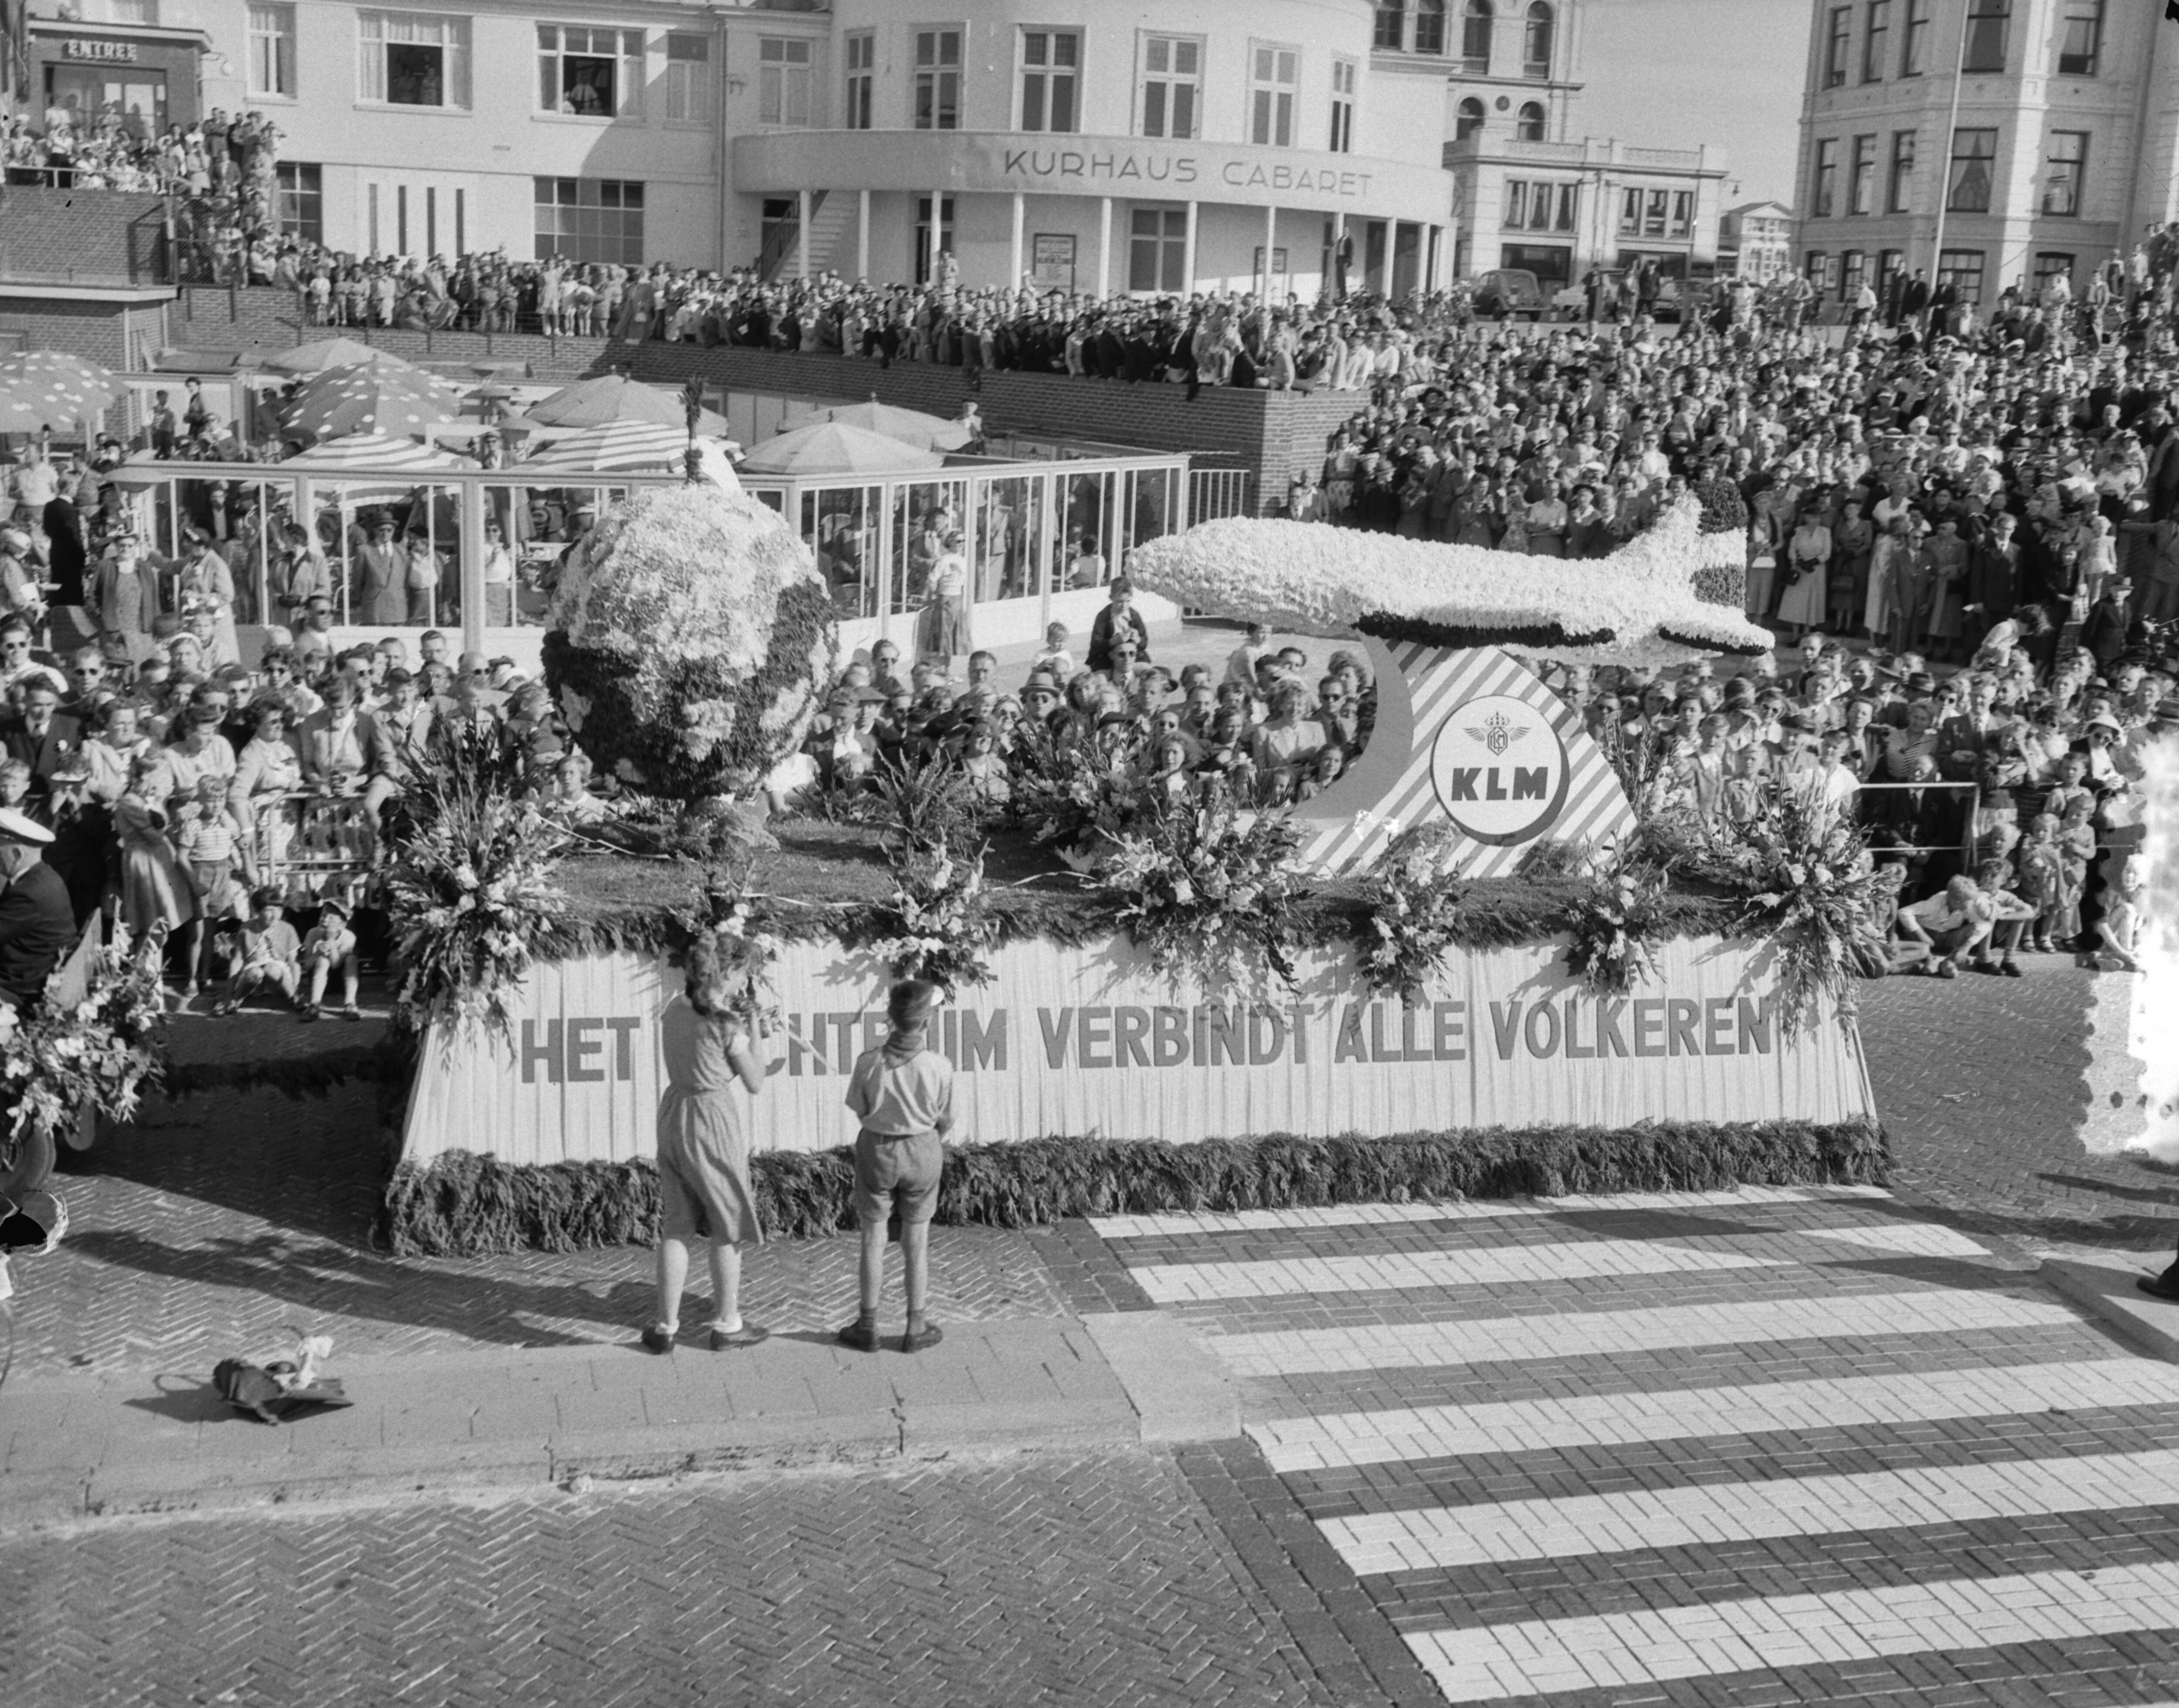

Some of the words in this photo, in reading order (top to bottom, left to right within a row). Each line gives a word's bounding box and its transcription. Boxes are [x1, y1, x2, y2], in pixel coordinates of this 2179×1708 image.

[68, 39, 137, 61] ENTREE
[1005, 149, 1198, 183] KURHAUS
[1222, 161, 1372, 196] CABARET
[1451, 767, 1548, 801] KLM
[522, 1016, 641, 1083] HET
[1037, 1005, 1315, 1070] VERBINDT
[1334, 1001, 1466, 1064] ALLE
[1489, 997, 1771, 1060] VOLKEREN
